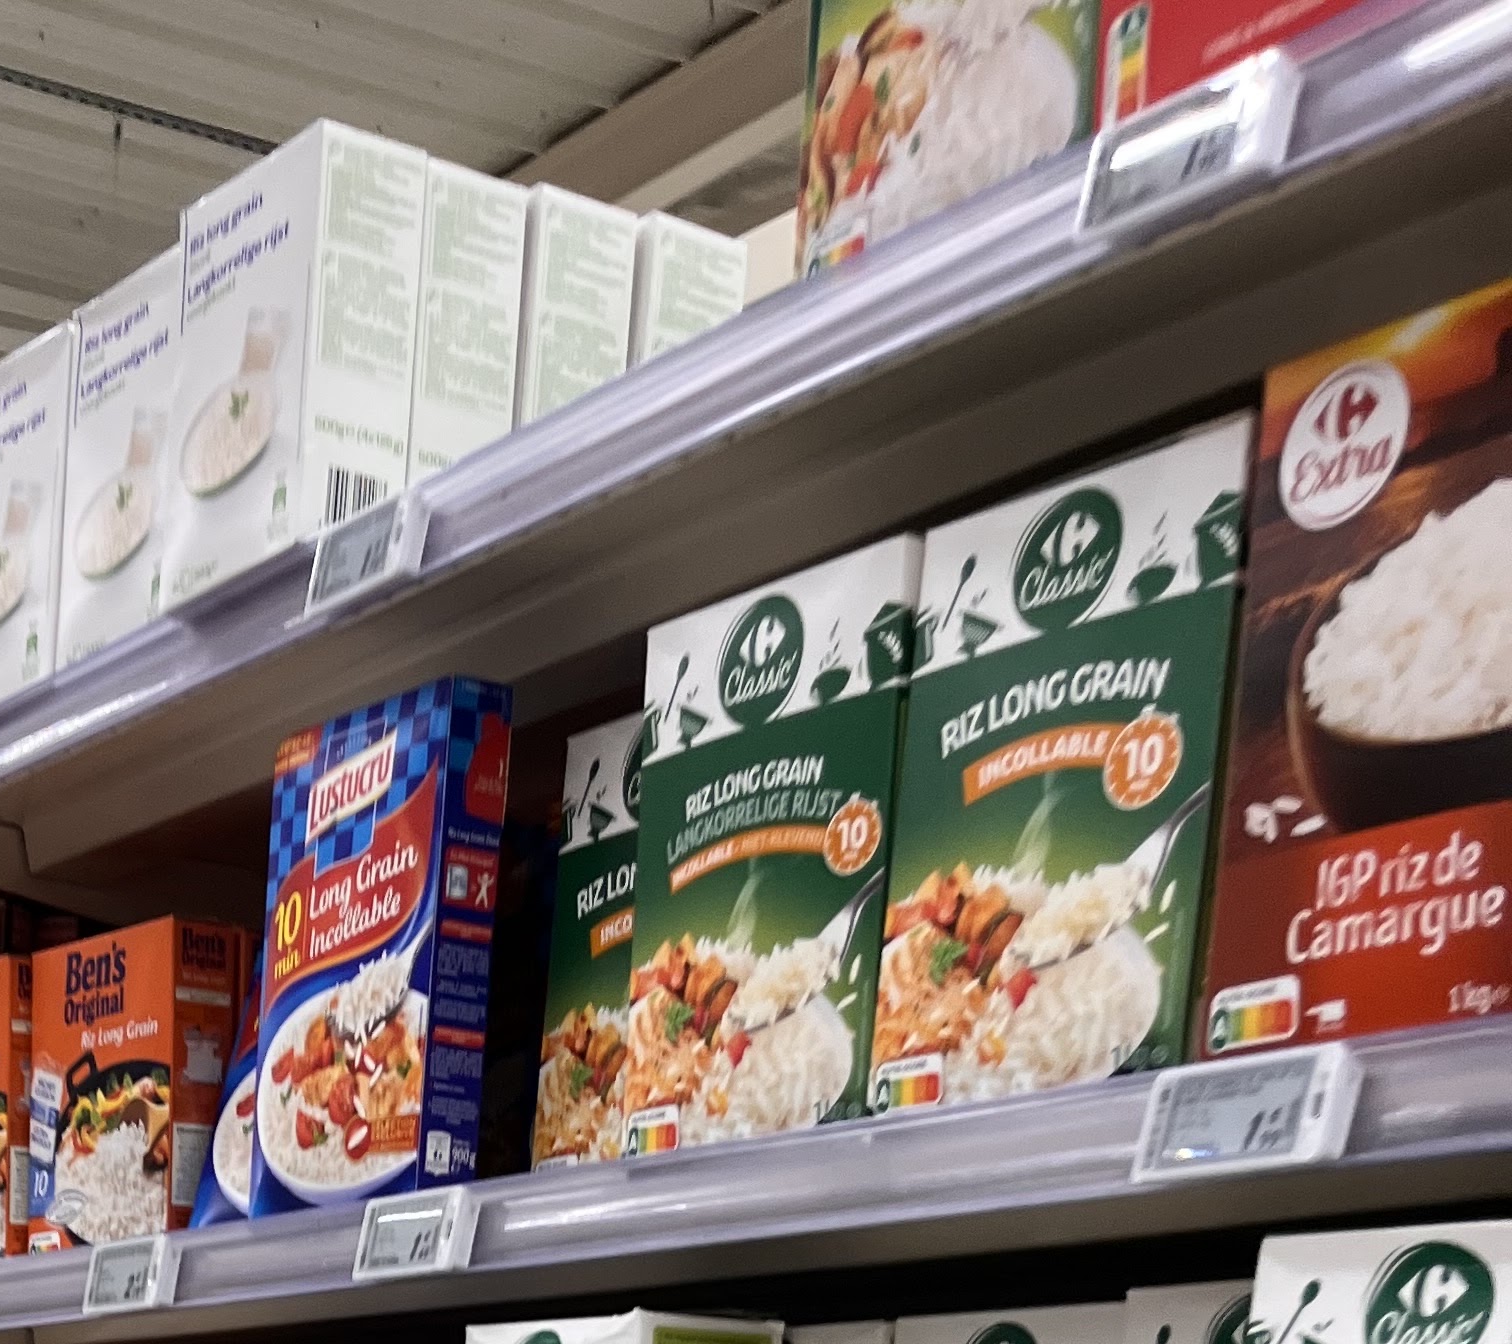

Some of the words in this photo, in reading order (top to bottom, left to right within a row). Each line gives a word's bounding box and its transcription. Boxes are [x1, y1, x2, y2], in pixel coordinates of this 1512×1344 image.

[1290, 431, 1392, 505] Extra
[941, 700, 985, 759] RIZ
[987, 669, 1068, 732] LONG
[1069, 658, 1172, 706] GRAIN
[686, 788, 712, 822] RIZ
[713, 765, 762, 808] LONG
[764, 755, 825, 789] GRAIN
[1124, 733, 1164, 778] 10
[668, 792, 788, 865] LANGKORRELIGE
[791, 788, 839, 817] RIJST
[835, 816, 869, 851] 10
[309, 877, 350, 921] Long
[357, 840, 418, 893] Grain
[1316, 850, 1376, 910] IGP
[1380, 844, 1429, 898] riz
[1433, 830, 1483, 887] de
[275, 891, 301, 951] 10
[311, 886, 400, 959] Incollable
[1287, 885, 1506, 964] Camargue
[65, 941, 126, 996] Ben's
[64, 988, 124, 1027] Original
